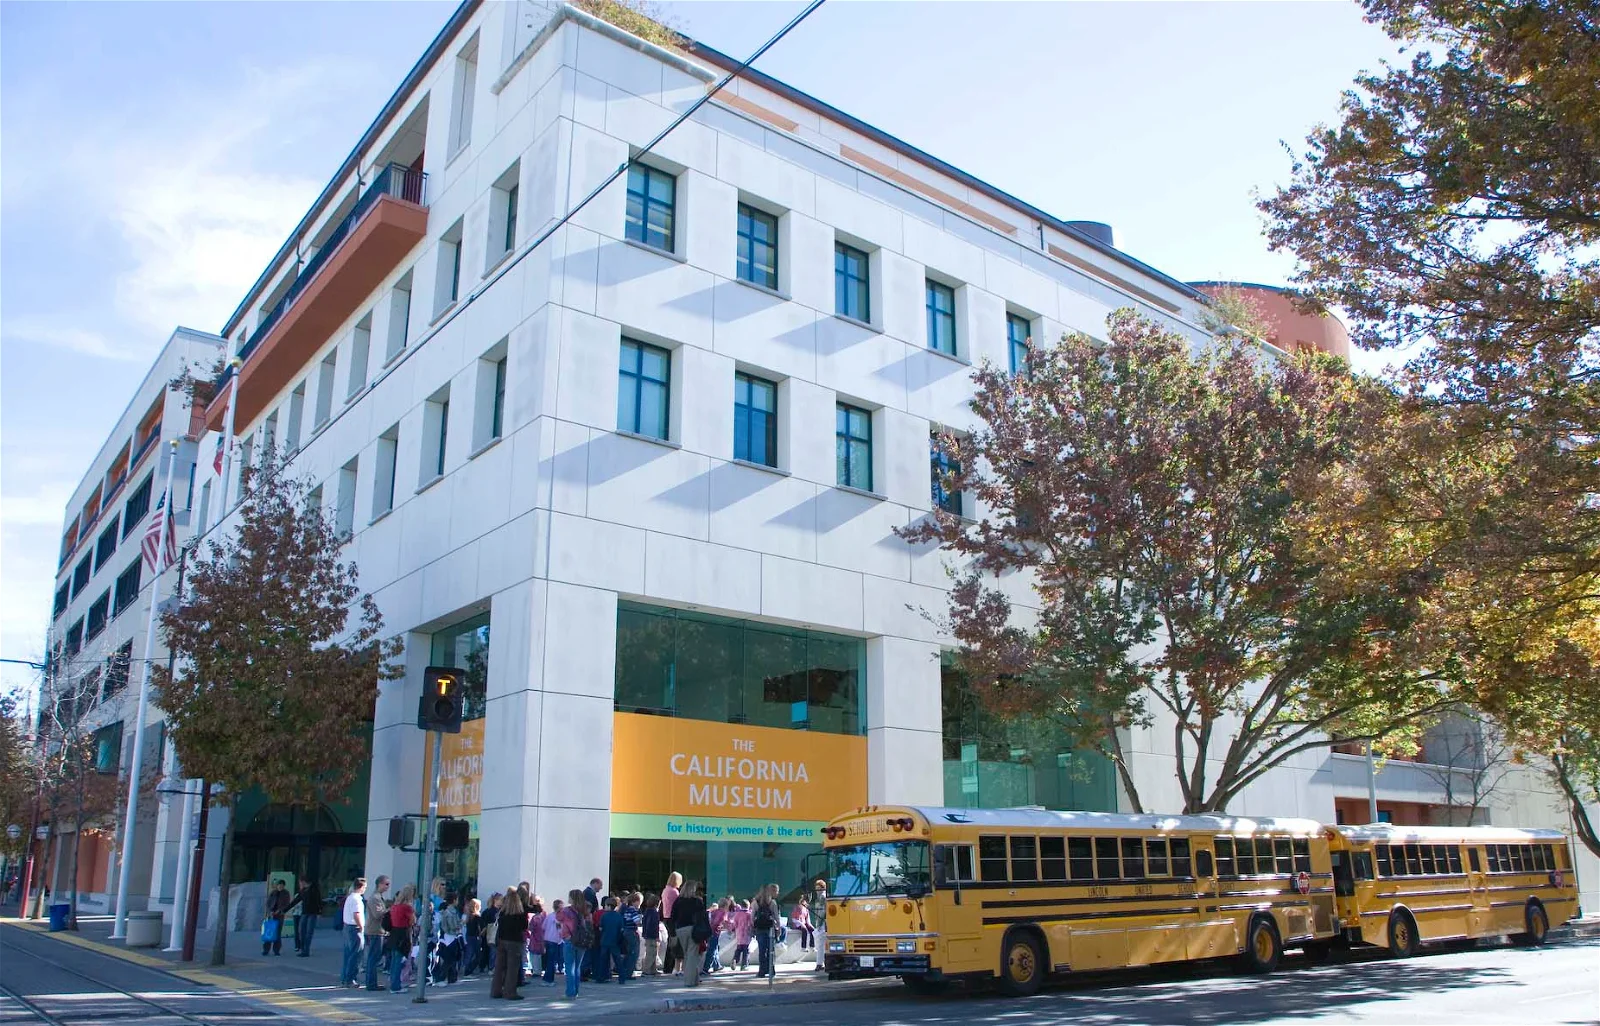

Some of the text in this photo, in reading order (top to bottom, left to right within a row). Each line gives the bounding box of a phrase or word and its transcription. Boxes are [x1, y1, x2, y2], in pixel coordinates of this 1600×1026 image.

[437, 679, 451, 695] T
[461, 736, 473, 750] THE
[732, 738, 756, 753] THE
[440, 752, 484, 779] ALIFOR
[670, 753, 809, 783] CALIFORNIA
[439, 781, 481, 807] MUSEU
[688, 783, 793, 810] MUSEUM
[666, 821, 814, 837] for history, women & the arts
[847, 819, 874, 837] SCHOOL
